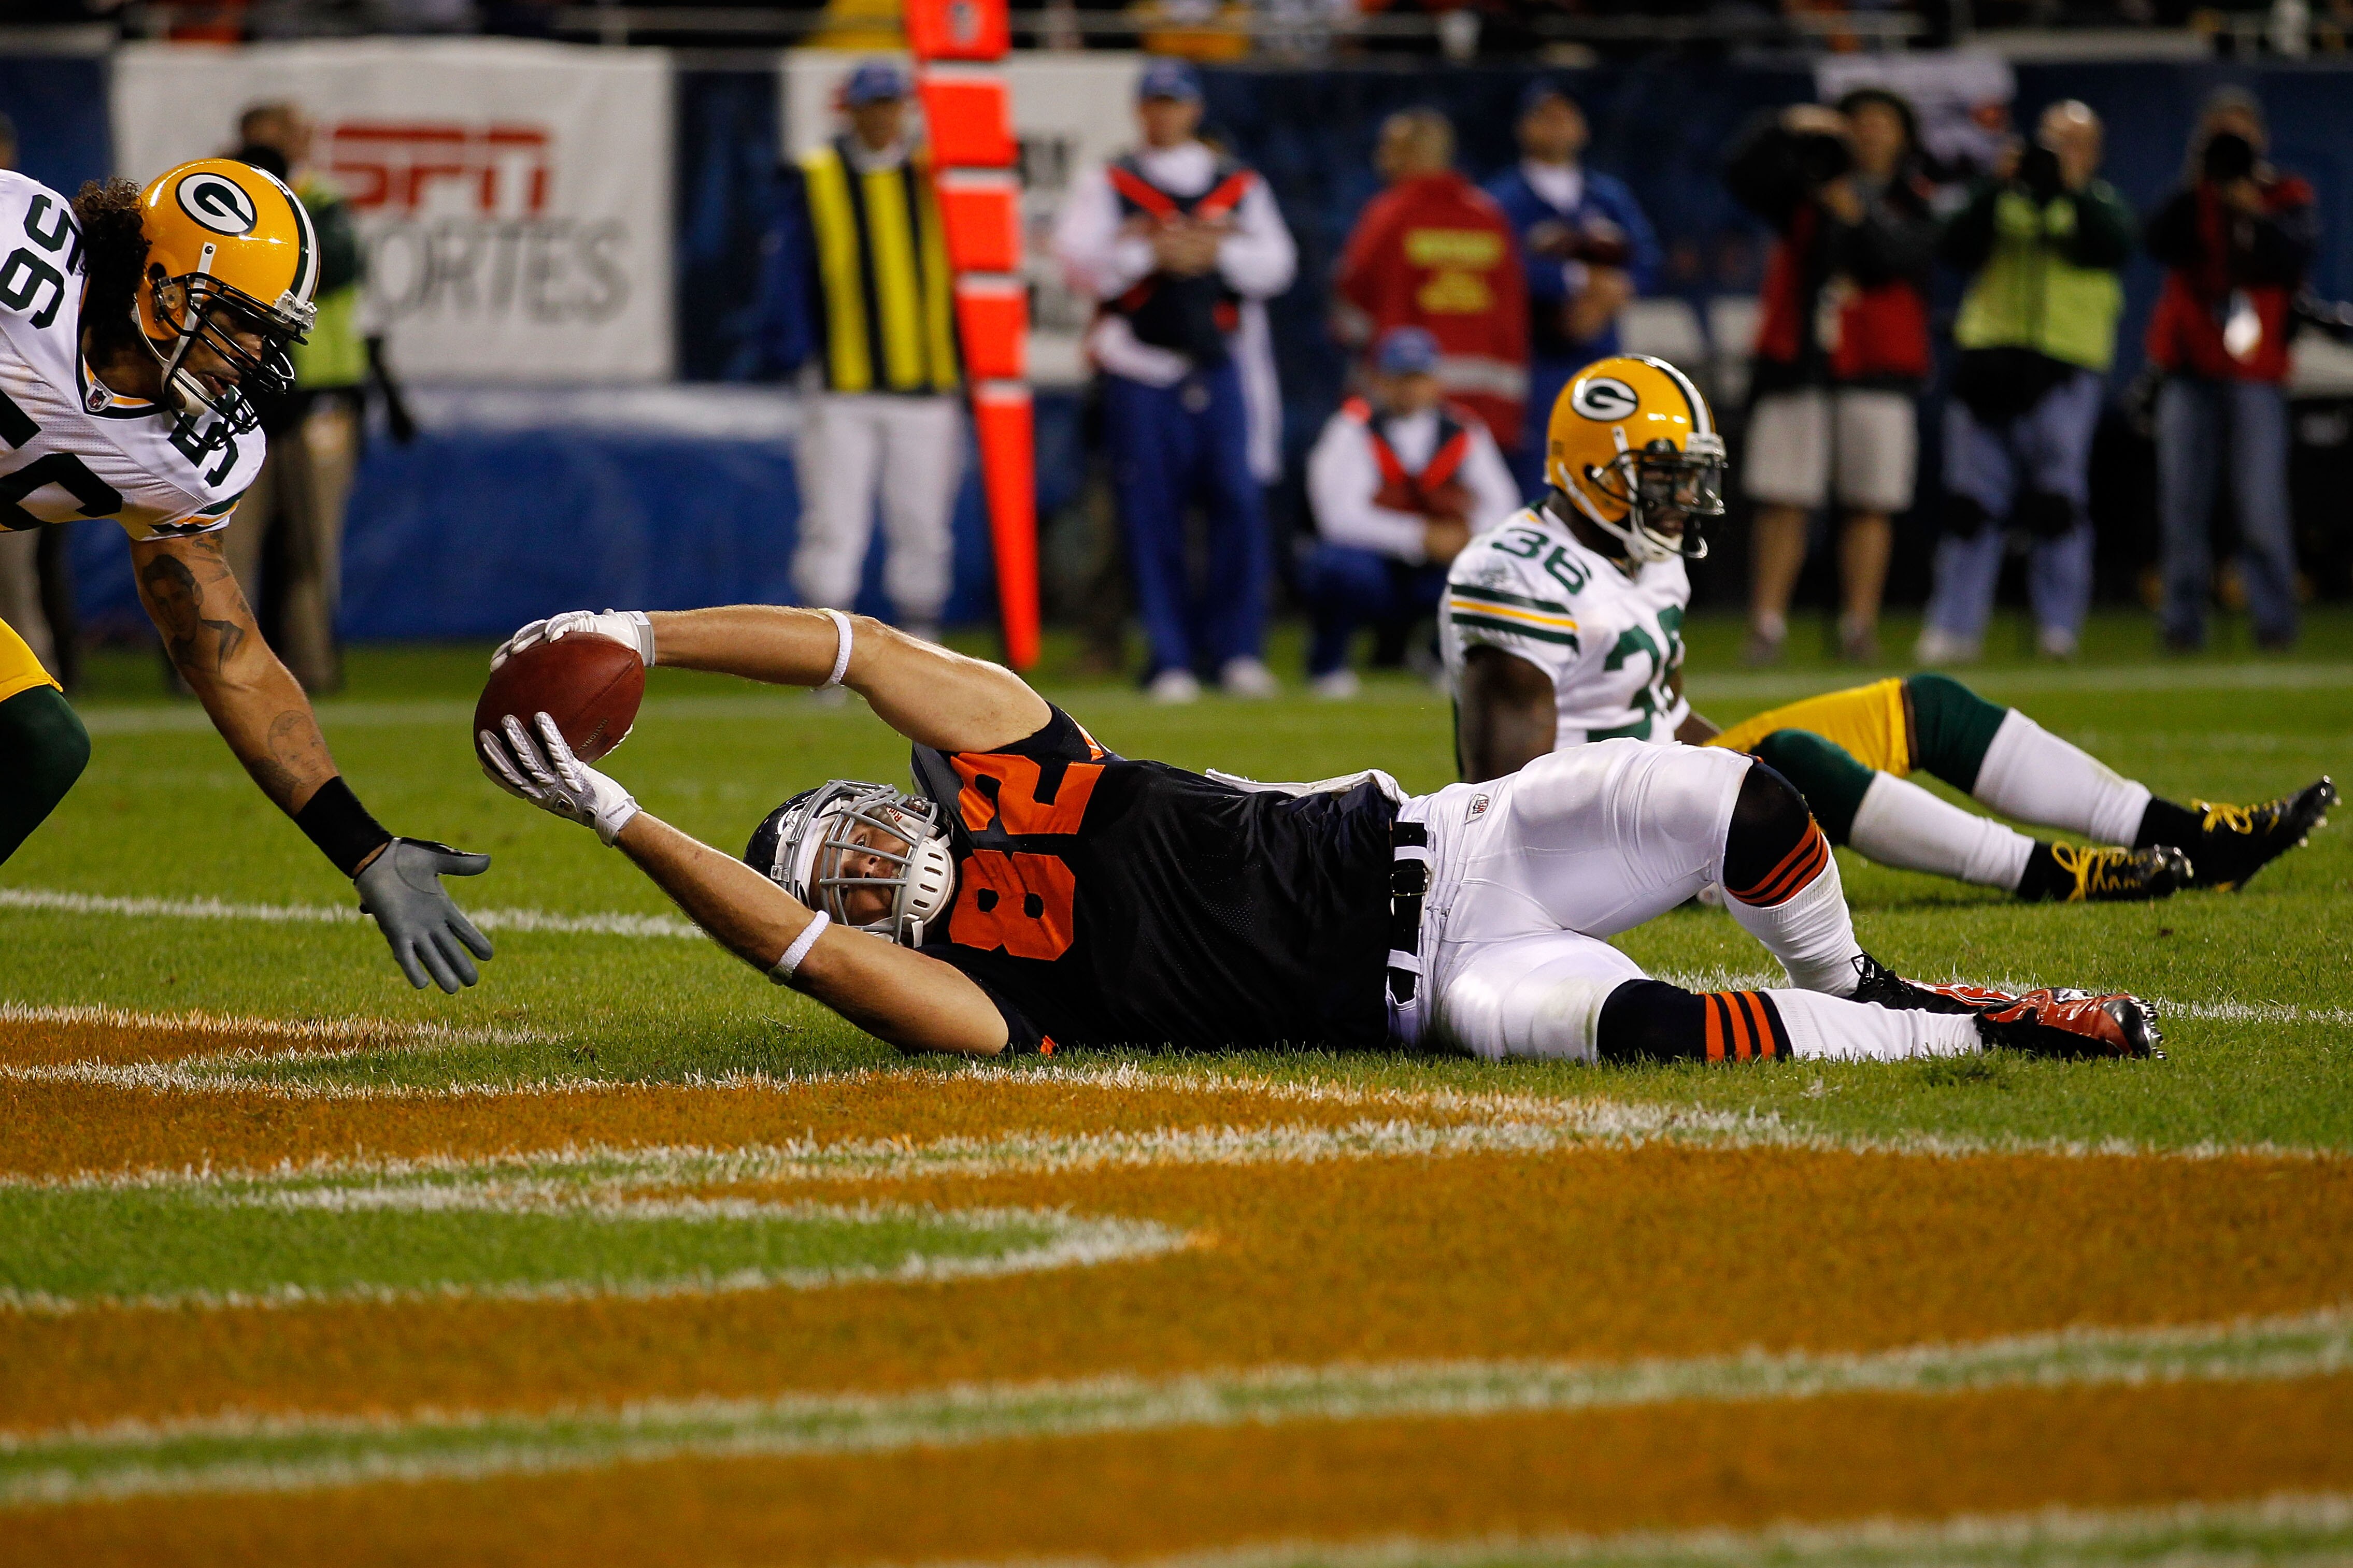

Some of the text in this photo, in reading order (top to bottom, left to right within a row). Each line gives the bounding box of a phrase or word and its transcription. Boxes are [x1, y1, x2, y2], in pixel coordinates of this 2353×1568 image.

[332, 125, 550, 213] SPN
[0, 194, 83, 329] 56
[1491, 527, 1591, 596] 36
[949, 752, 1105, 961] 82
